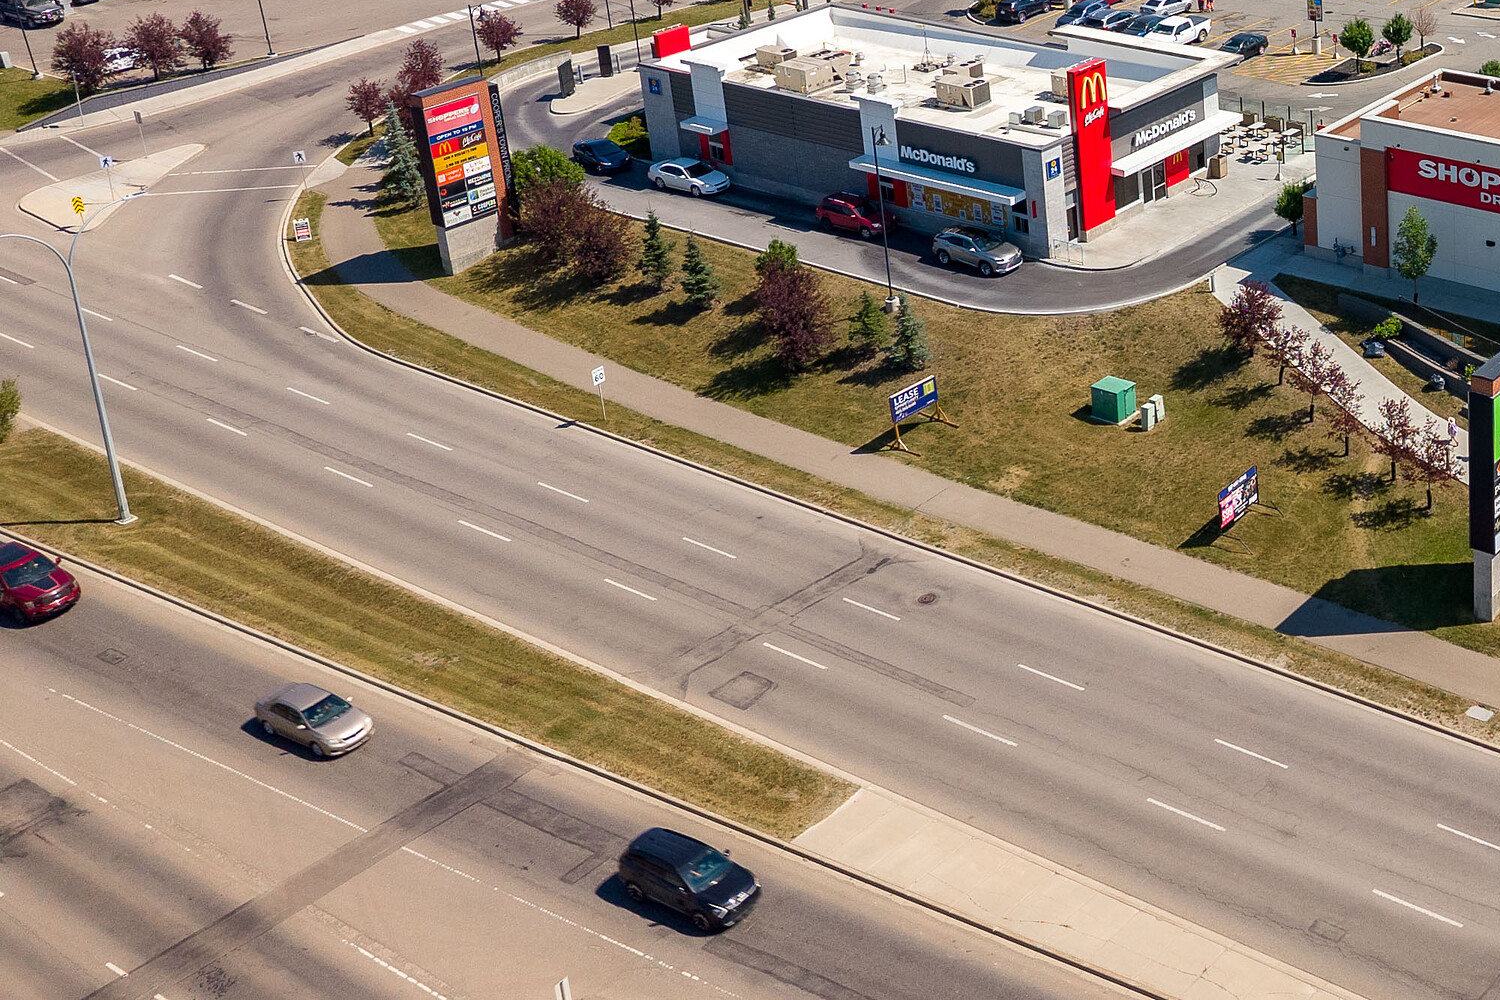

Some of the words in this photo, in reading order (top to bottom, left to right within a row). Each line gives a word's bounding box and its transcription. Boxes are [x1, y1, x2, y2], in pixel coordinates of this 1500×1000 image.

[436, 132, 452, 140] OPEN
[1134, 109, 1197, 147] McDonald's
[498, 134, 508, 160] TOWN
[900, 145, 976, 173] McDonald's
[893, 387, 919, 406] LEASE
